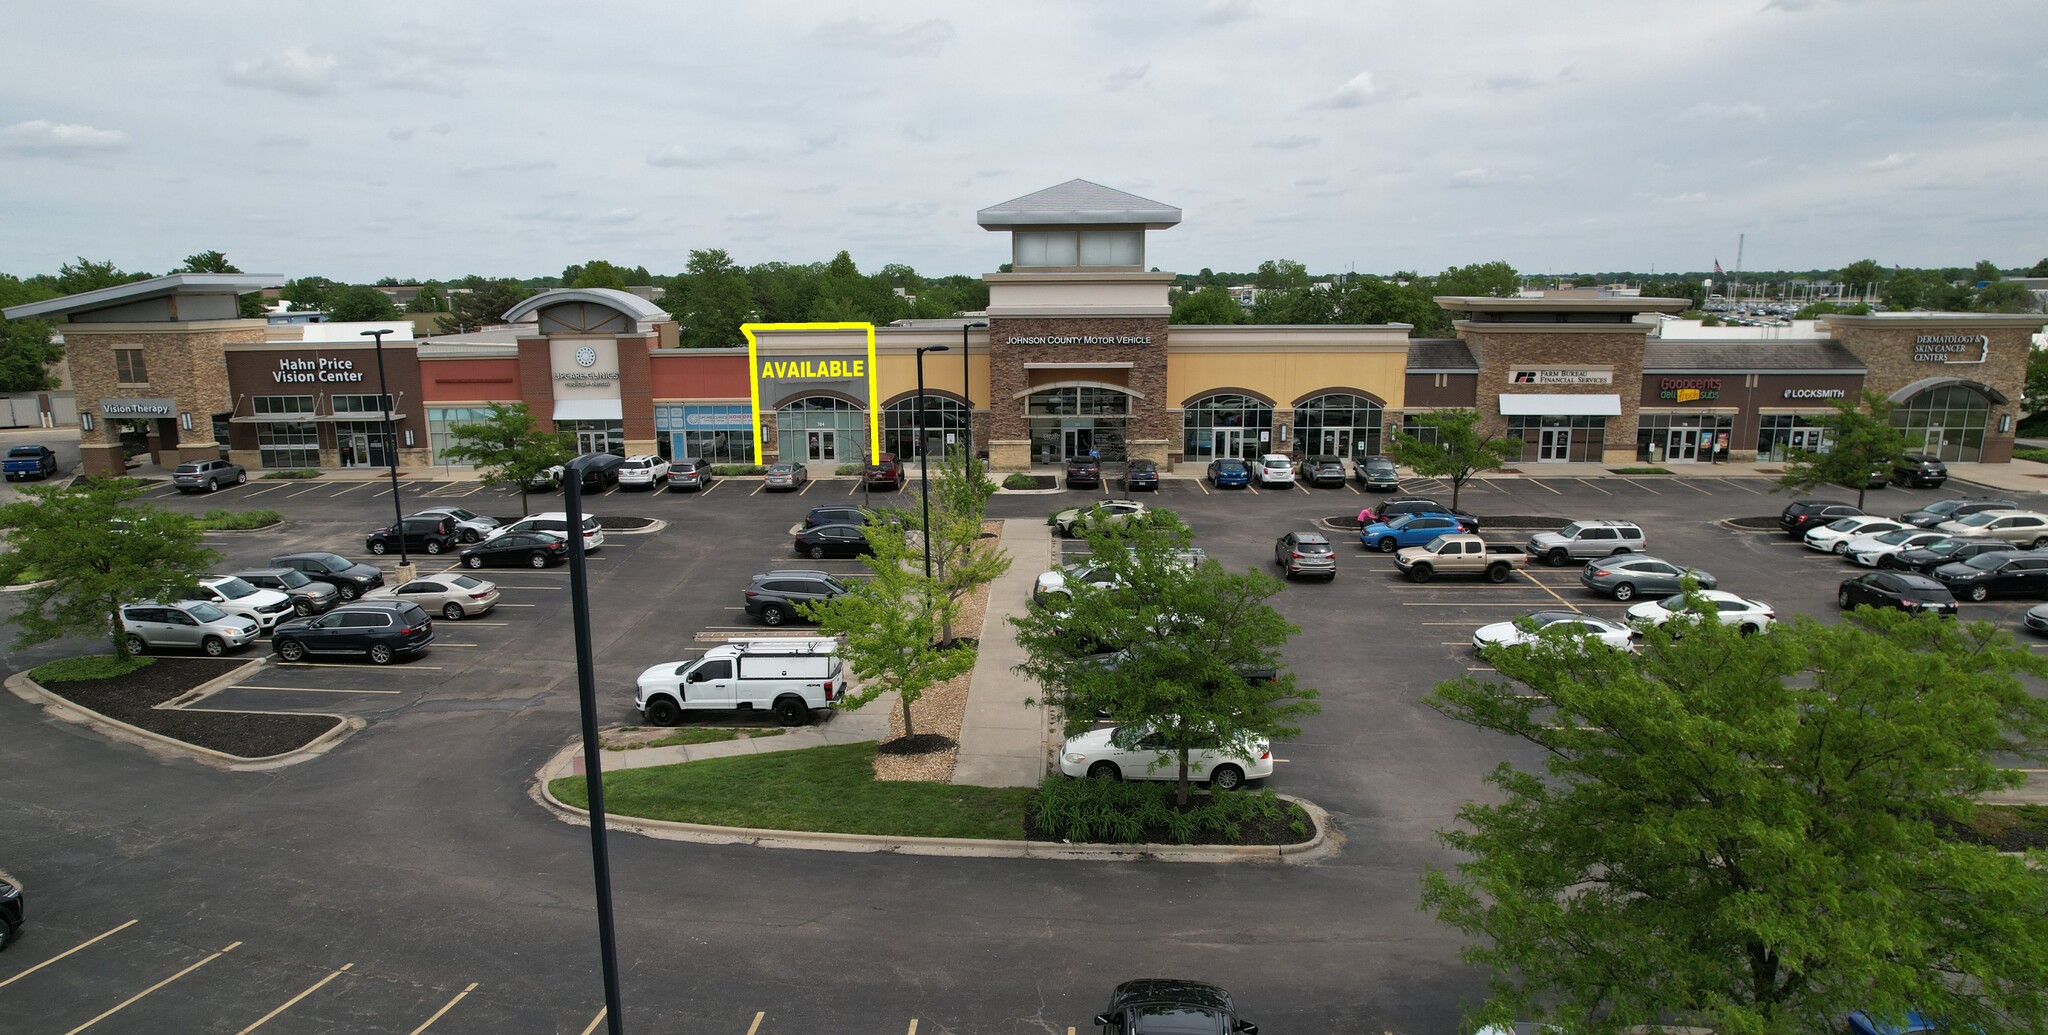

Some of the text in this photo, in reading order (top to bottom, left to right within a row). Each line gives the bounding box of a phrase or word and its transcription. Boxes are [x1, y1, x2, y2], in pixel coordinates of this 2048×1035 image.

[1006, 336, 1151, 344] JOHNSON COUNTY MOTOR VEHICLE
[1917, 335, 1973, 343] DERMATOLOGY
[1914, 353, 1948, 361] CENTERS
[280, 358, 353, 370] Hahn Price
[272, 370, 363, 382] Vision Center
[587, 372, 619, 380] CLINICS
[1660, 390, 1676, 399] deli
[1700, 390, 1719, 399] subs
[1792, 389, 1845, 398] LOCKSMITH
[103, 404, 168, 414] Vision Therapy
